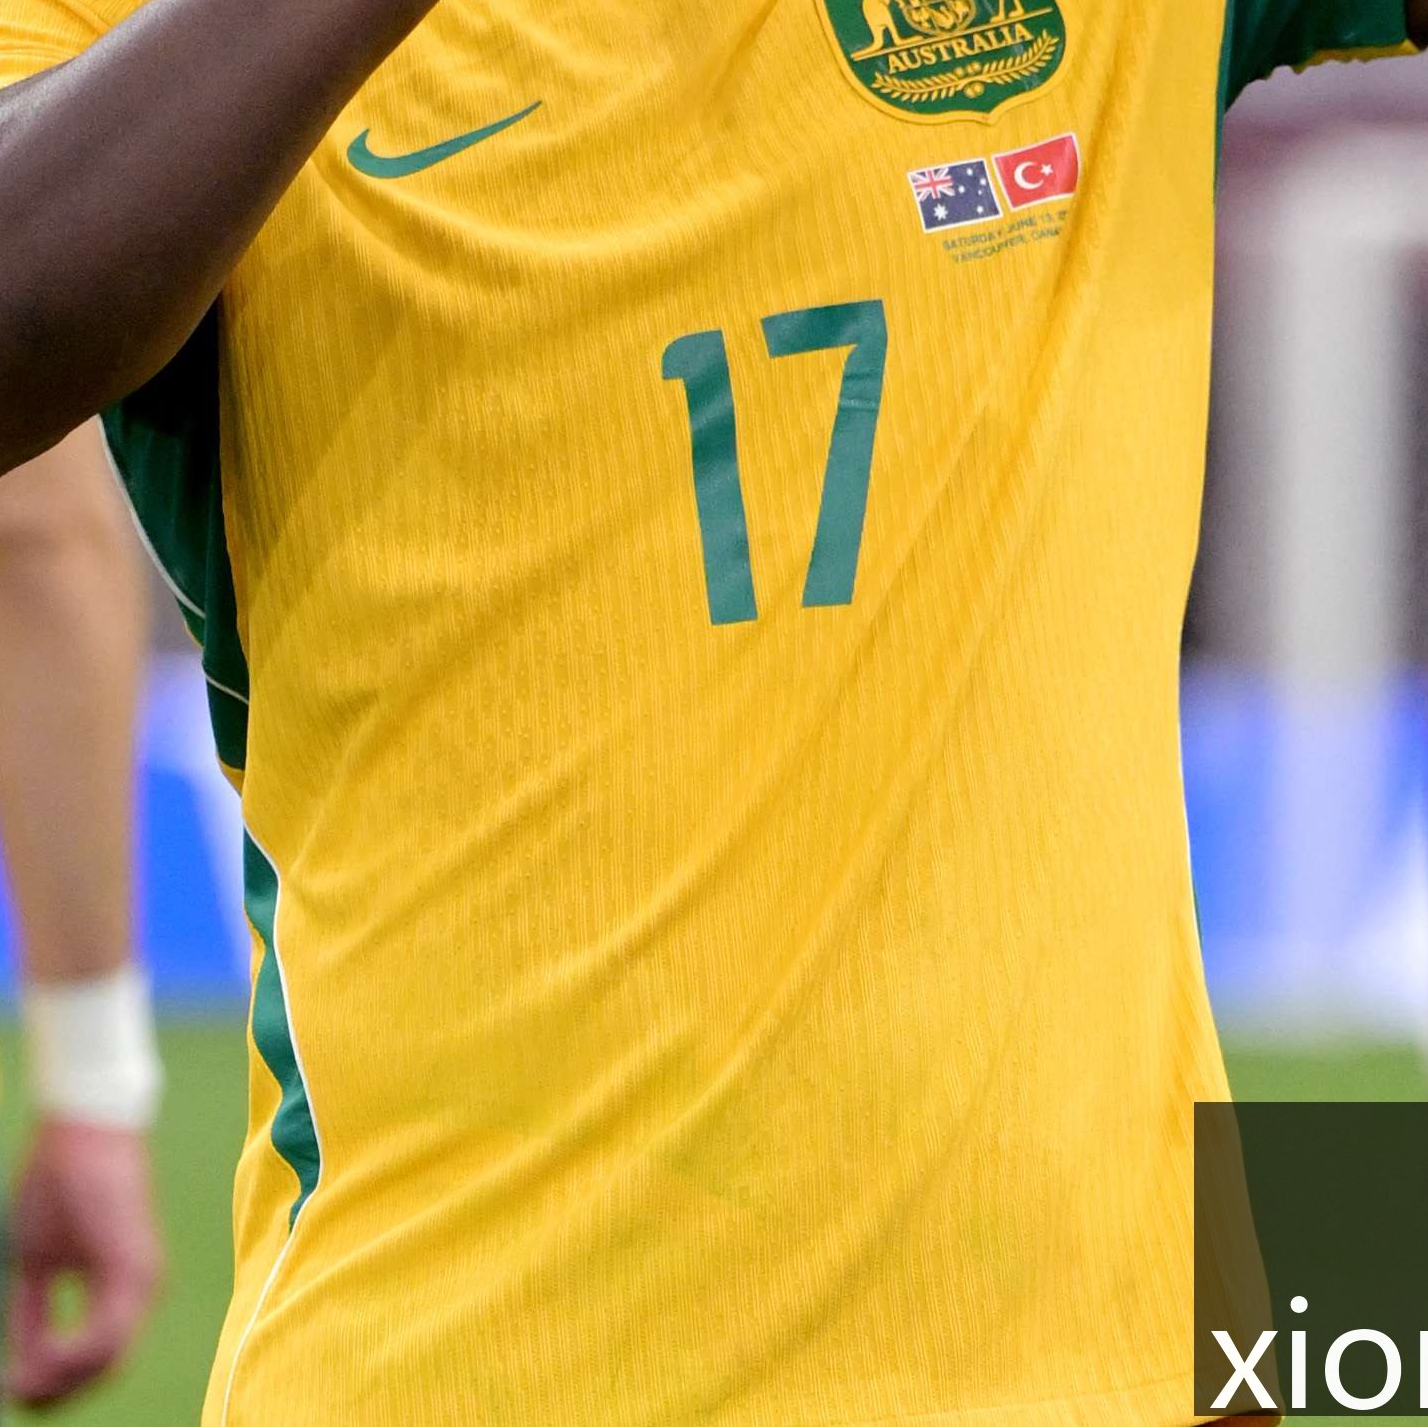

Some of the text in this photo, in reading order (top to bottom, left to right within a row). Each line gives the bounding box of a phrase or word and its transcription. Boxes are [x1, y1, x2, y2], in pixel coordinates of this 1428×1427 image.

[888, 23, 1035, 74] AUSTRALIA
[942, 229, 1003, 251] SATURDAY
[1007, 216, 1037, 234] JUNE
[661, 299, 888, 625] 17
